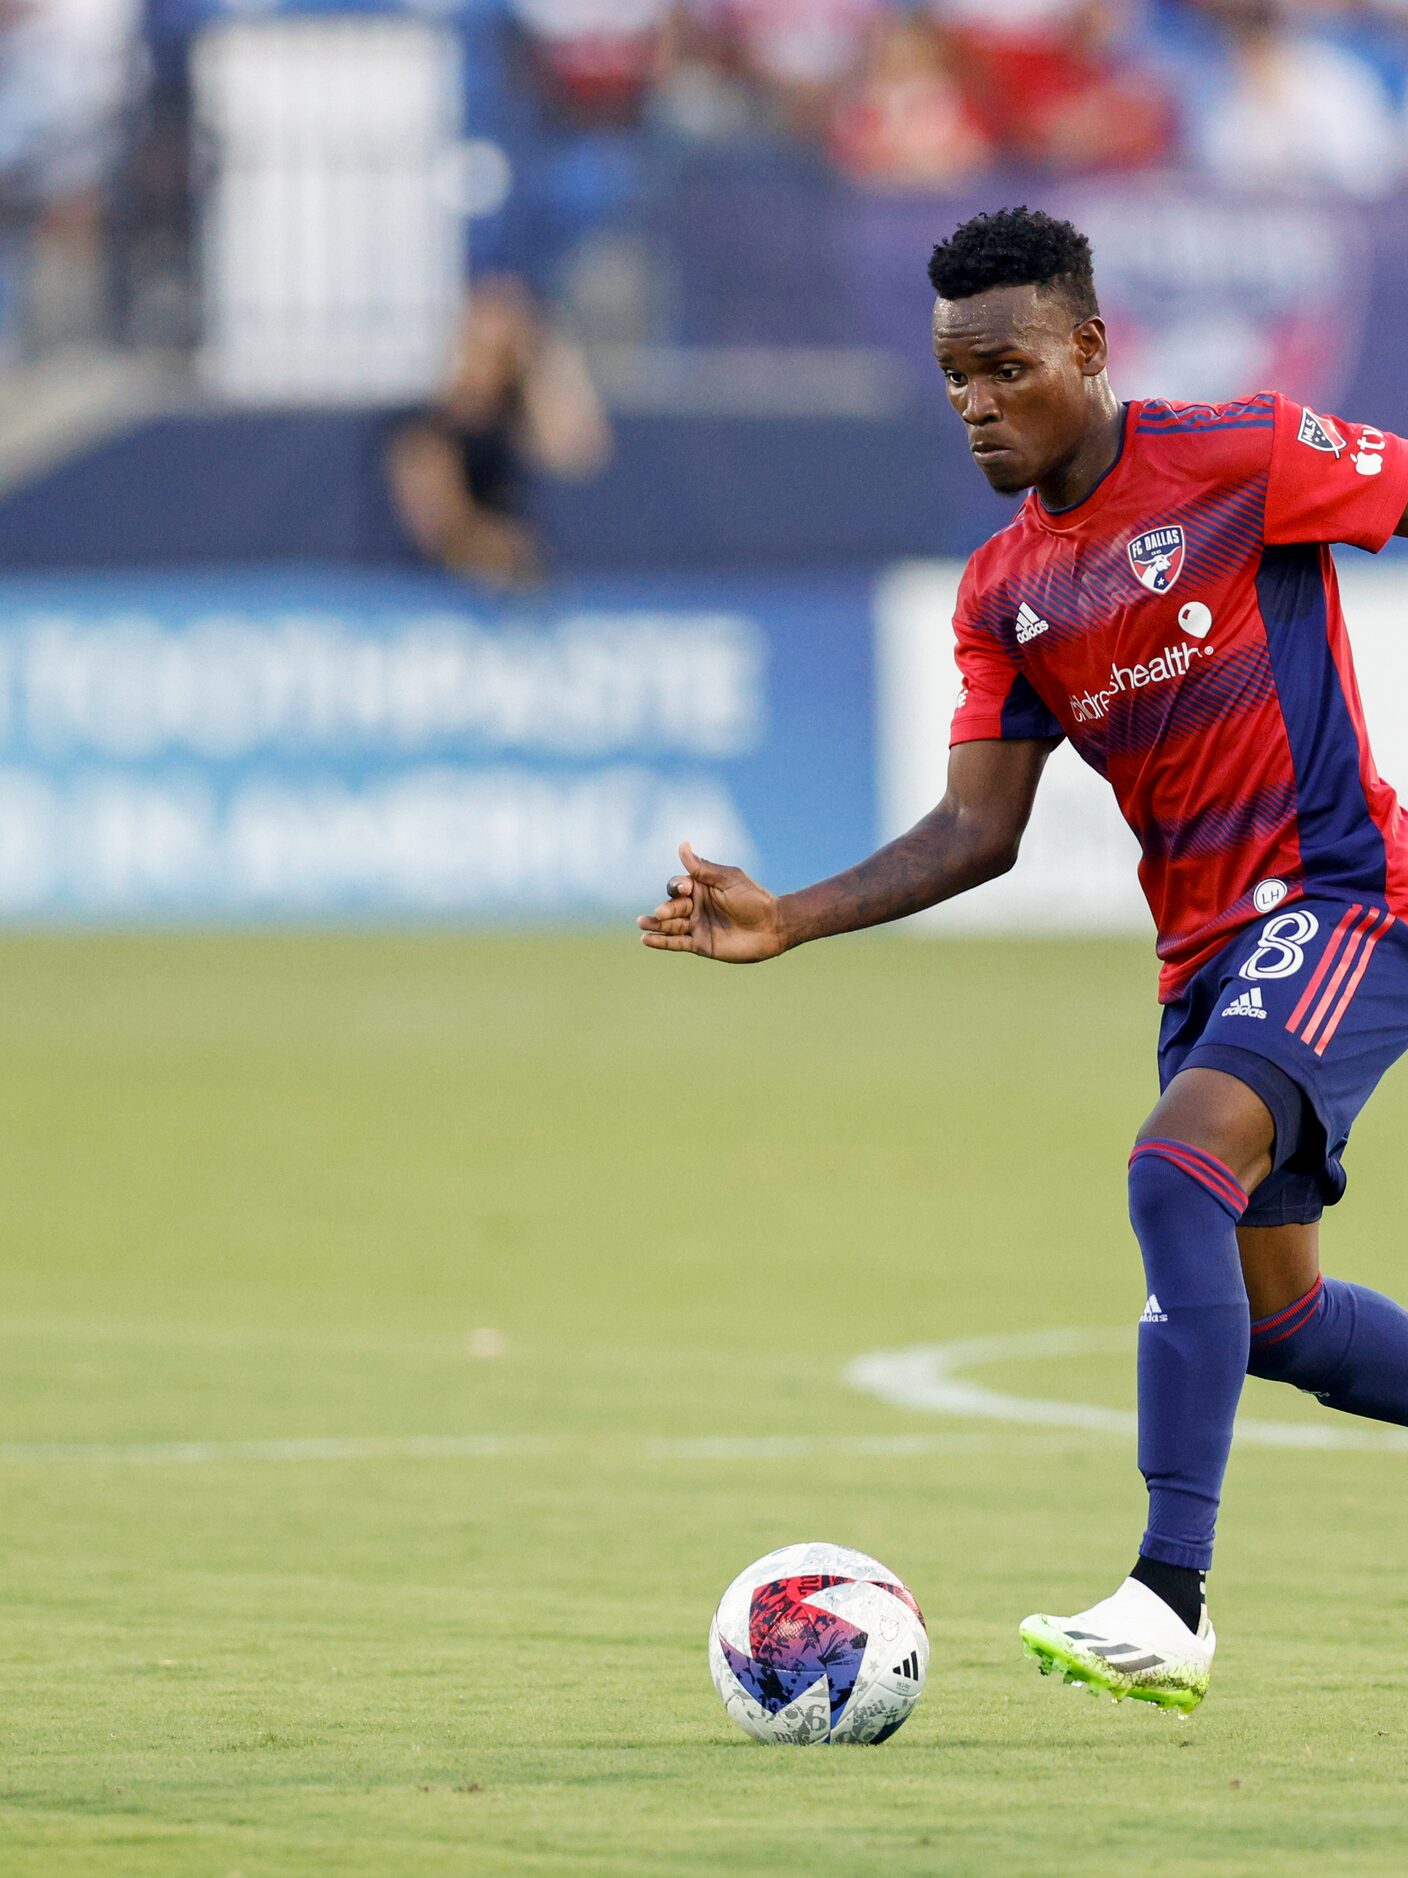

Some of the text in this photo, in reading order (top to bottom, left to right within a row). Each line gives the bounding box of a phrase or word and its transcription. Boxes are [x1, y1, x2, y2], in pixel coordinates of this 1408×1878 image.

[1302, 419, 1317, 442] MLS
[1131, 529, 1180, 558] FC DALLAS
[1016, 619, 1049, 644] adidas
[1261, 889, 1280, 905] LH
[1238, 910, 1319, 981] 8
[1221, 1003, 1268, 1020] adidas
